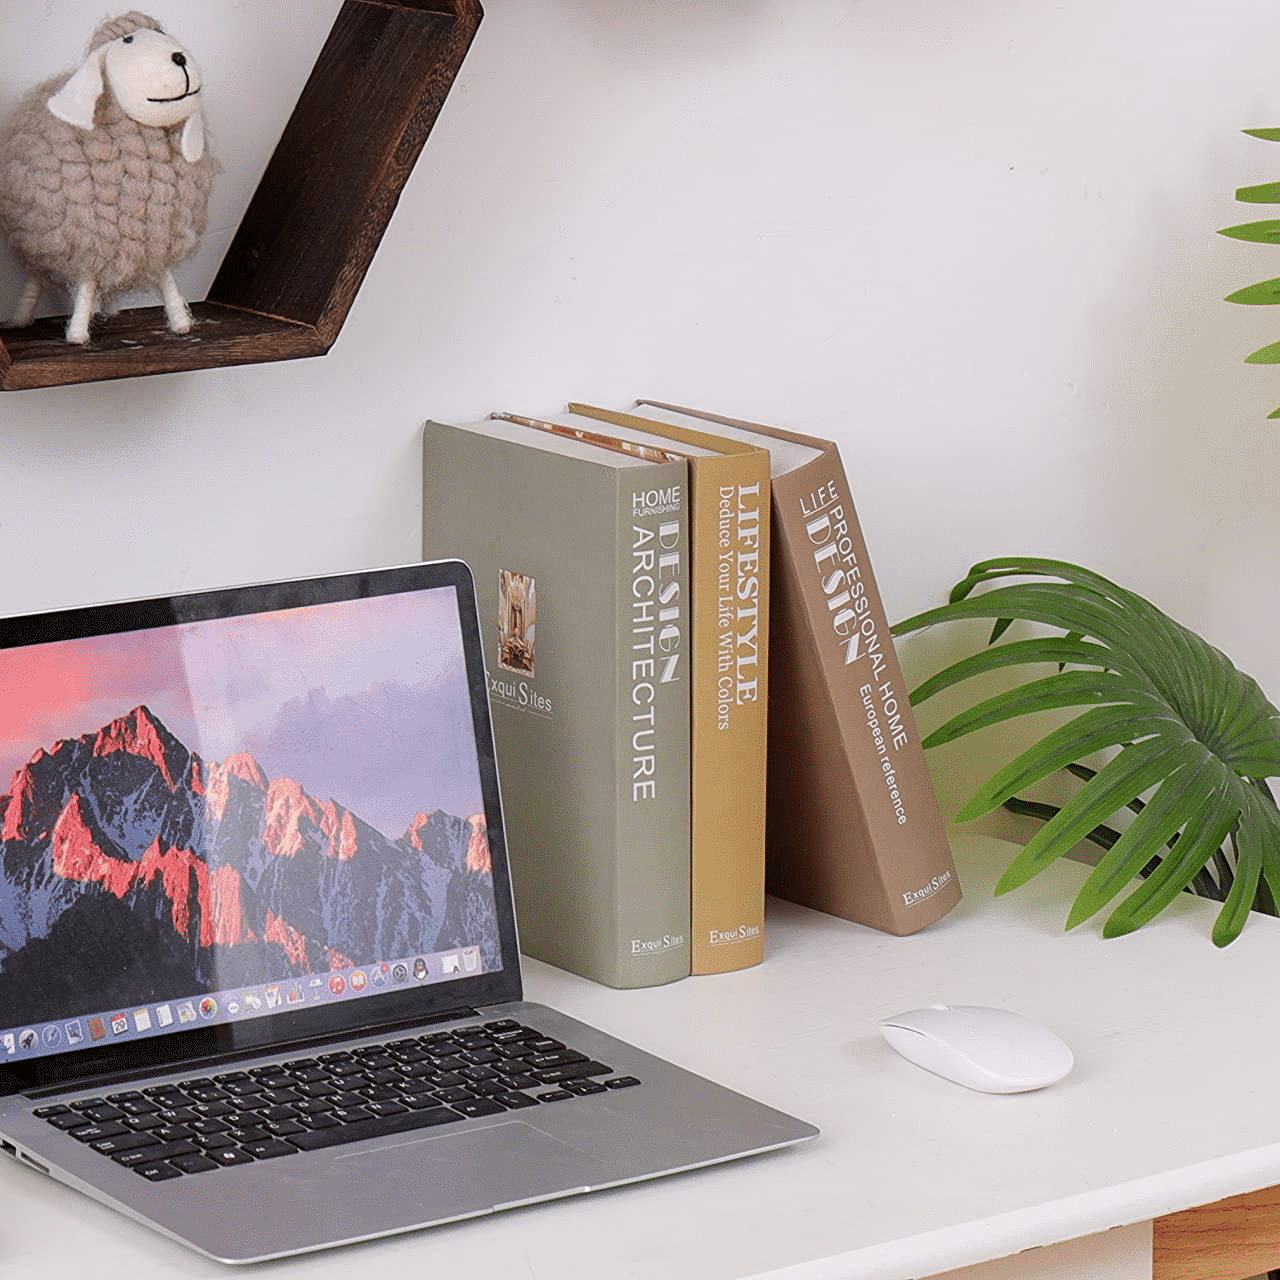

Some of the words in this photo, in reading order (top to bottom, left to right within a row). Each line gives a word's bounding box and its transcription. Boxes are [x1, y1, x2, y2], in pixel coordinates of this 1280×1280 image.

[632, 485, 680, 509] HOME
[632, 503, 680, 517] FURNISHING
[719, 485, 735, 548] Deduce
[799, 480, 839, 515] LIFE
[718, 550, 734, 592] Your
[736, 481, 760, 705] LIFESTYLE
[805, 514, 867, 666] DESIGN
[658, 520, 680, 683] DESIGN
[718, 595, 734, 628] Life
[830, 505, 887, 682] PROFESSIONAL
[878, 681, 908, 751] HOME
[632, 525, 656, 802] ARCHITECTURE
[718, 631, 734, 672] With
[718, 676, 734, 730] Colors
[860, 683, 887, 756] European
[880, 755, 907, 825] reference
